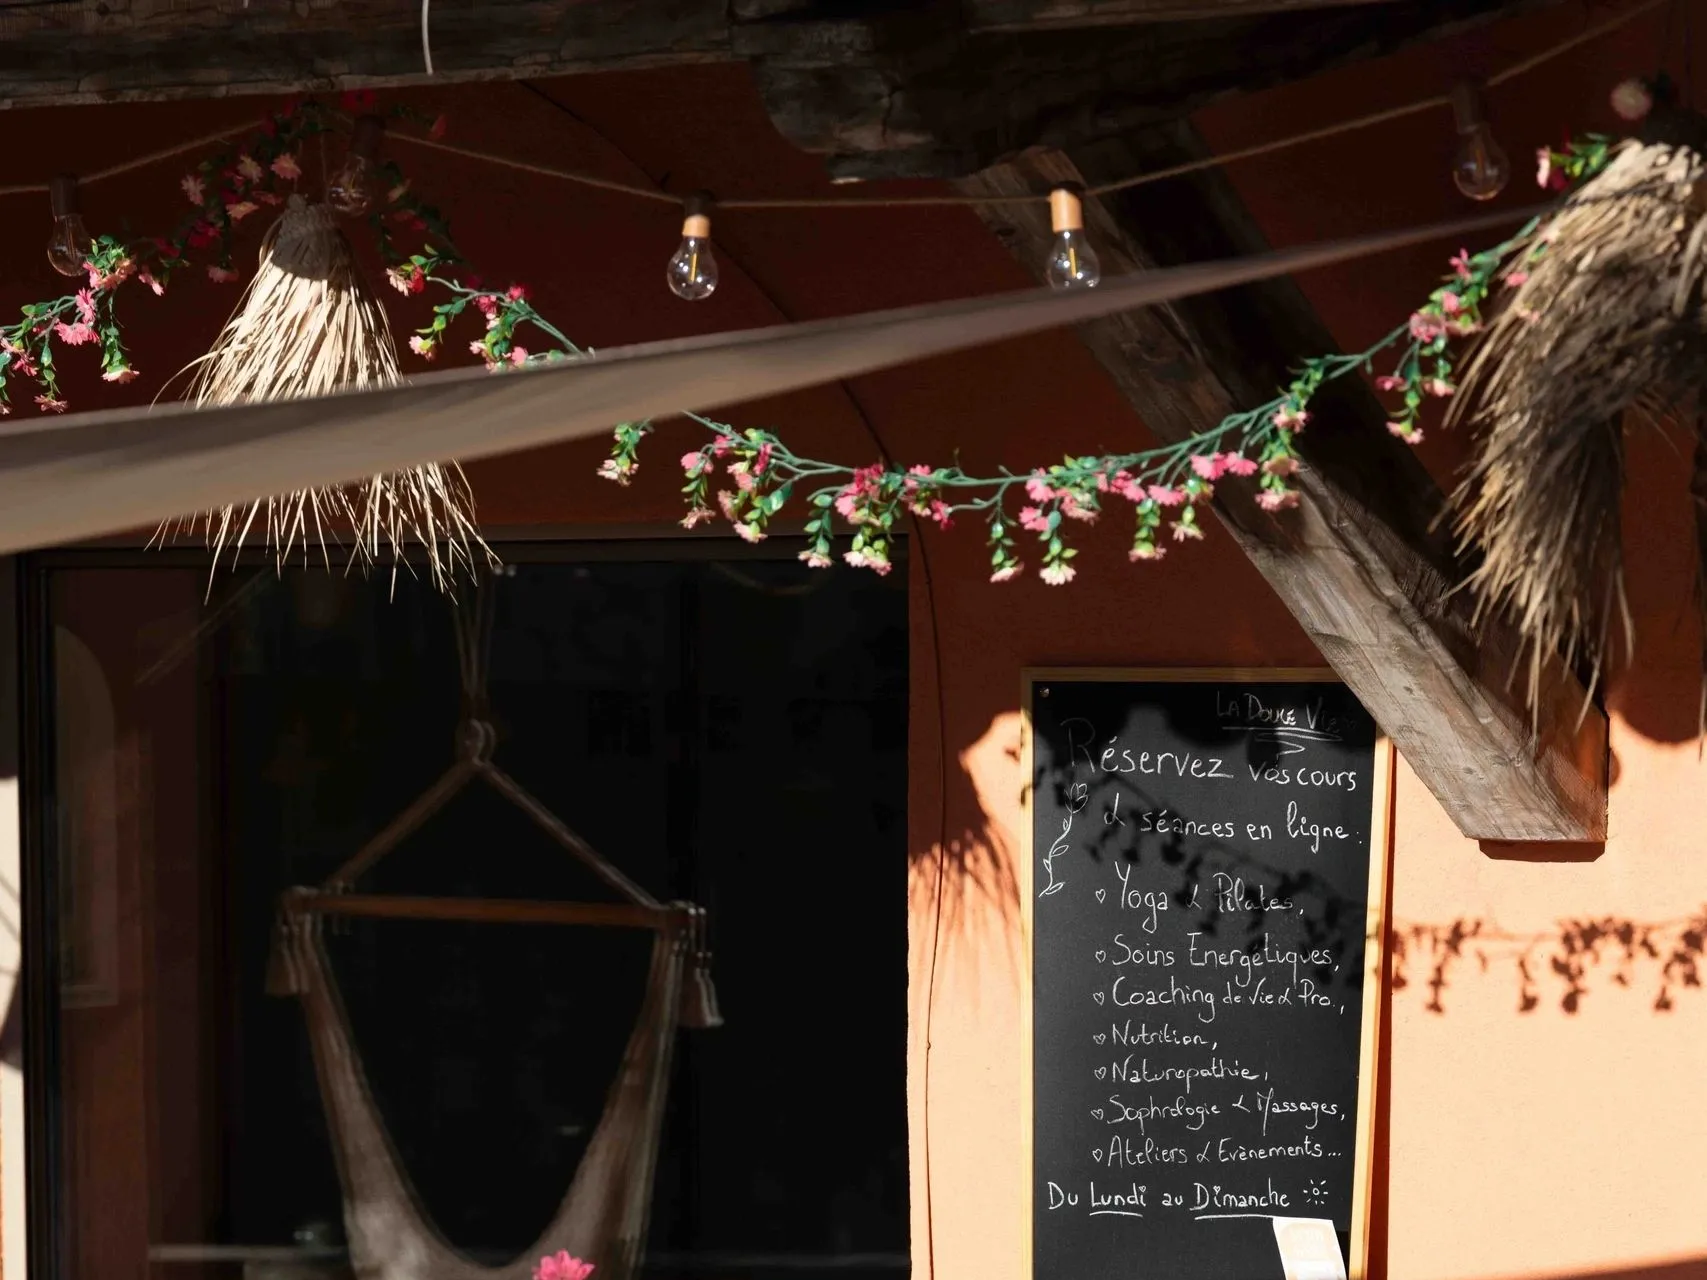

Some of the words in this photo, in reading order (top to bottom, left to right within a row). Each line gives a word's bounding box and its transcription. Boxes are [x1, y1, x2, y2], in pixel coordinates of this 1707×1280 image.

[1060, 717, 1234, 779] Réservez
[1249, 763, 1290, 785] vos
[1296, 767, 1358, 791] cours
[1140, 809, 1235, 839] séances
[1246, 821, 1273, 841] en
[1114, 861, 1169, 934] Yoga
[1212, 872, 1304, 915] Pilates,
[1112, 933, 1175, 967] Soins
[1112, 976, 1215, 1024] Coaching
[1222, 981, 1242, 1005] de
[1248, 977, 1274, 1006] Vie
[1112, 1019, 1218, 1051] Nutrition,
[1112, 1053, 1269, 1095] Naturopathie,
[1106, 1094, 1221, 1136] Sophrologie
[1256, 1087, 1345, 1137] Massages,
[1107, 1134, 1188, 1169] Ateliers
[1047, 1181, 1079, 1211] Du
[1090, 1181, 1147, 1208] Lundi
[1161, 1192, 1184, 1207] au
[1189, 1178, 1291, 1212] Dimanche
